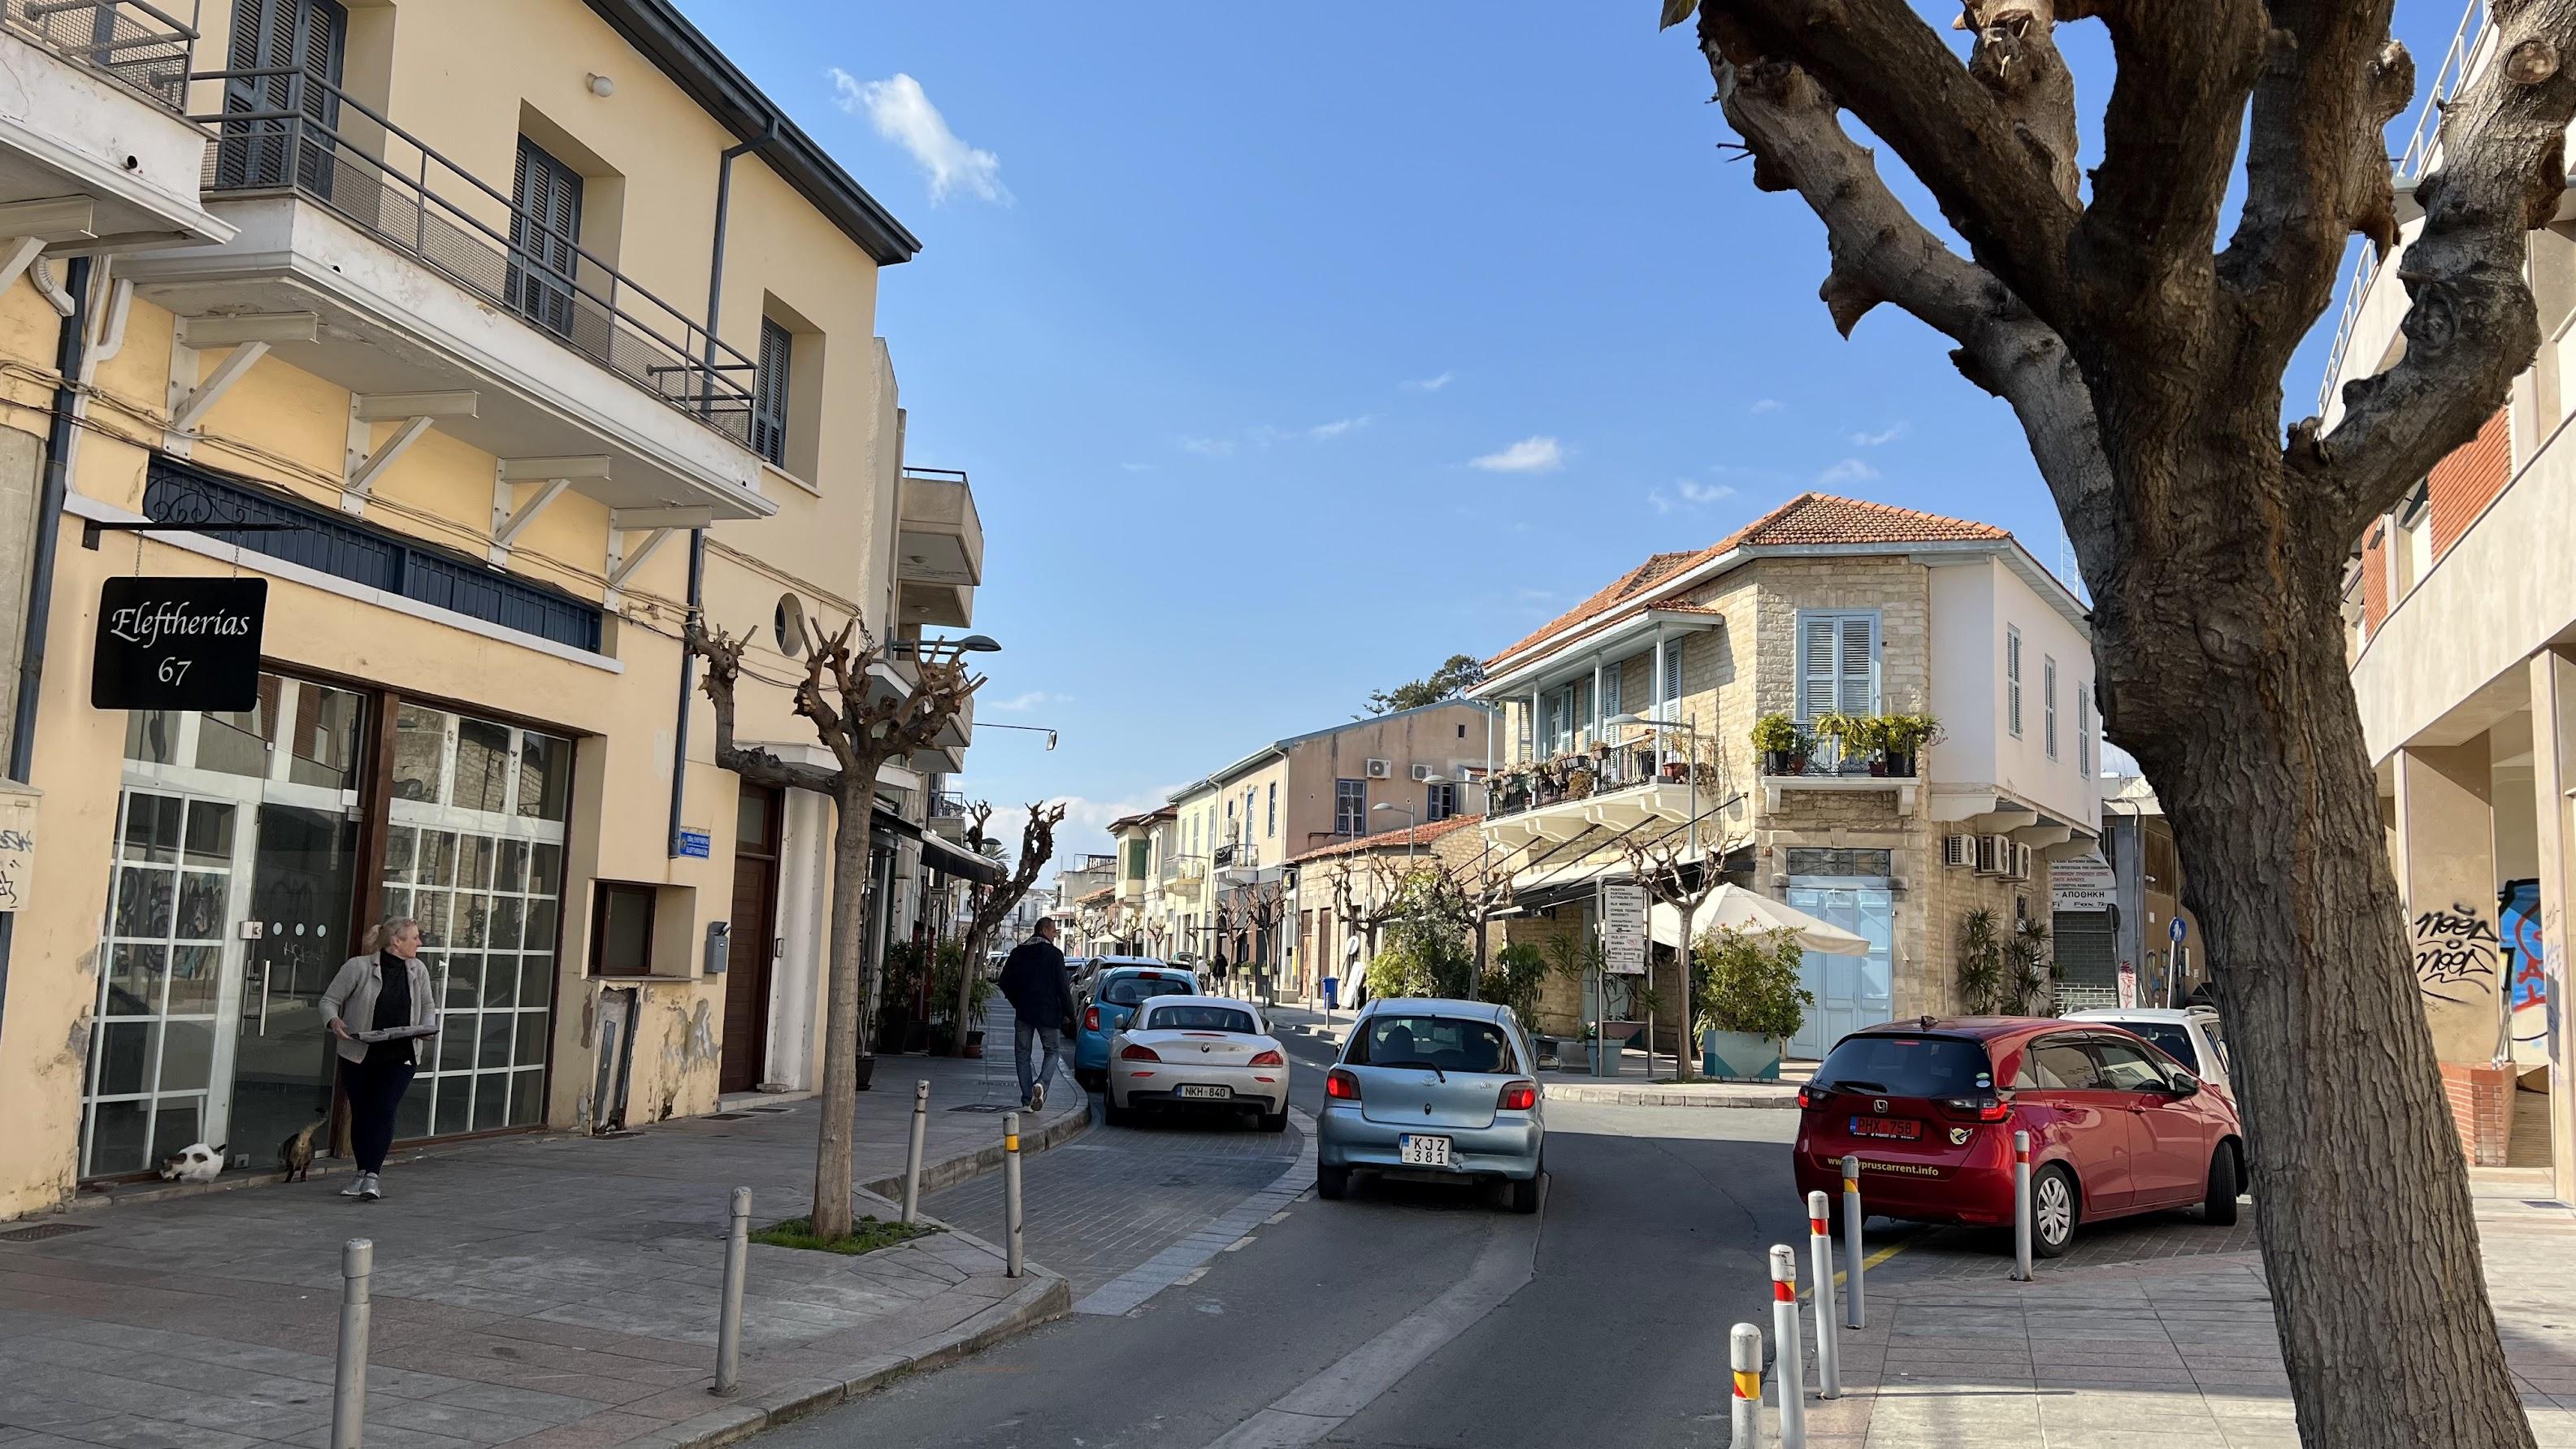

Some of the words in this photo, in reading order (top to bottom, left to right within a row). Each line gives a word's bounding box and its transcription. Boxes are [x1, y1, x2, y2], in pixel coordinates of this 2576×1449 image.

[111, 601, 250, 649] Eleftherias
[158, 657, 192, 687] 67
[1185, 1087, 1203, 1096] NKH
[1208, 1087, 1225, 1097] 840
[1858, 1118, 1880, 1133] PHX
[1890, 1121, 1912, 1134] 758
[1414, 1138, 1445, 1152] KJZ
[1414, 1151, 1444, 1165] 381
